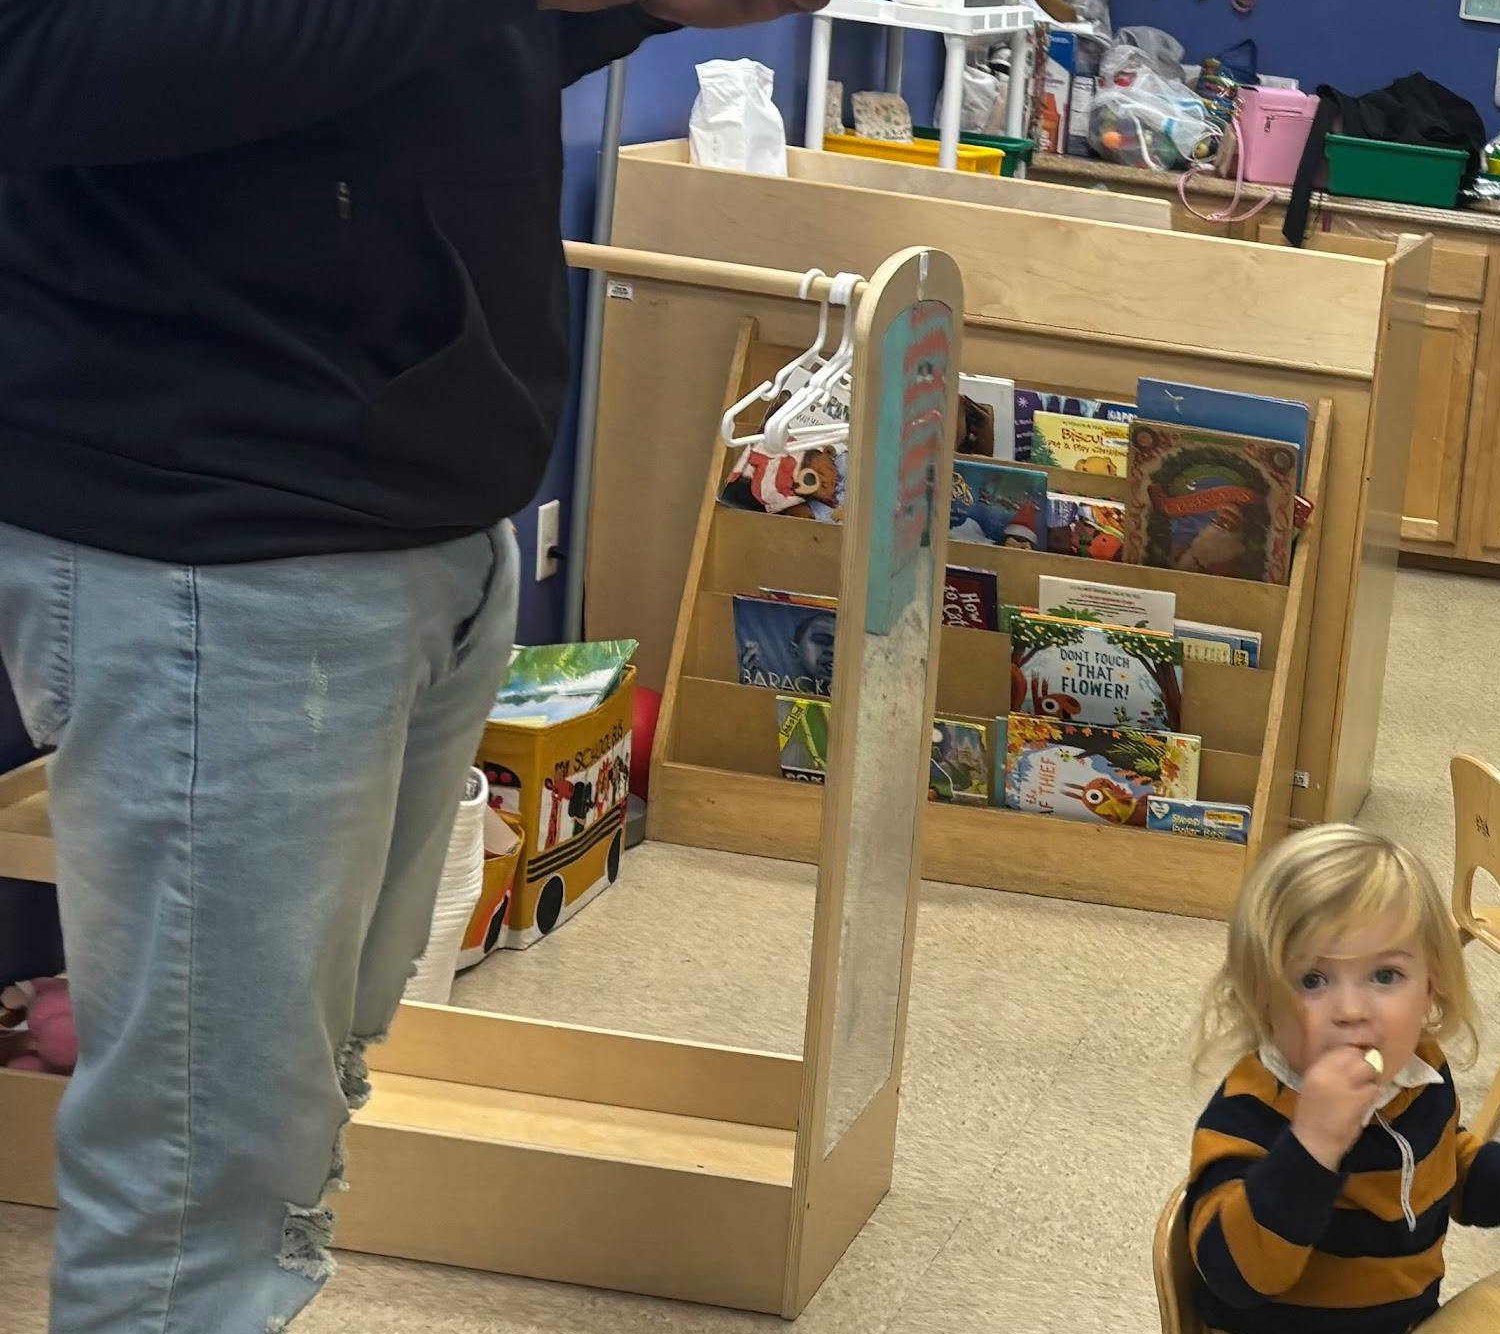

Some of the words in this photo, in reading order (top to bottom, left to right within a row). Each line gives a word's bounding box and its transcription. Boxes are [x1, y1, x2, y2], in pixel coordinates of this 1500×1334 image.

[960, 594, 982, 623] How
[1076, 663, 1114, 681] THAT
[1095, 652, 1129, 668] TOUCH
[1062, 676, 1129, 700] FLOWER!
[1039, 757, 1057, 795] THIEF
